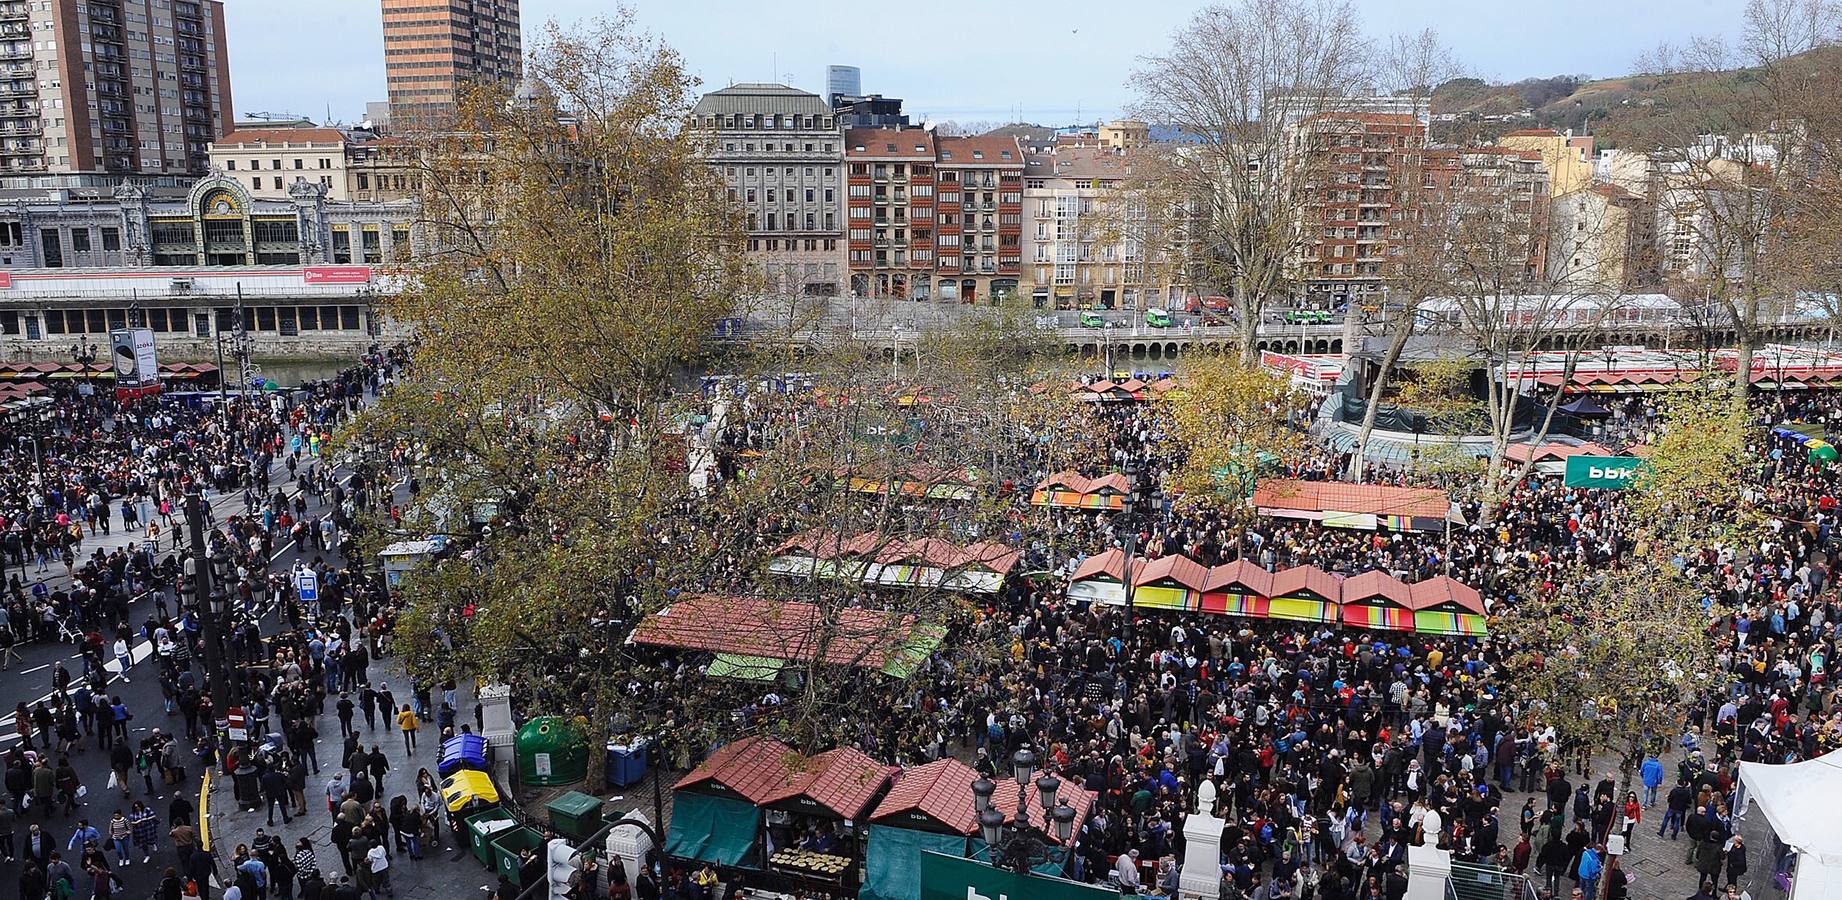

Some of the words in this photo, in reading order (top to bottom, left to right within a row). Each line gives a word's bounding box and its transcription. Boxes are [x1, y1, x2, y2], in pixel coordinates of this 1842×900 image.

[1589, 466, 1634, 480] bbk
[800, 798, 817, 807] bbk
[910, 813, 928, 822] bbk
